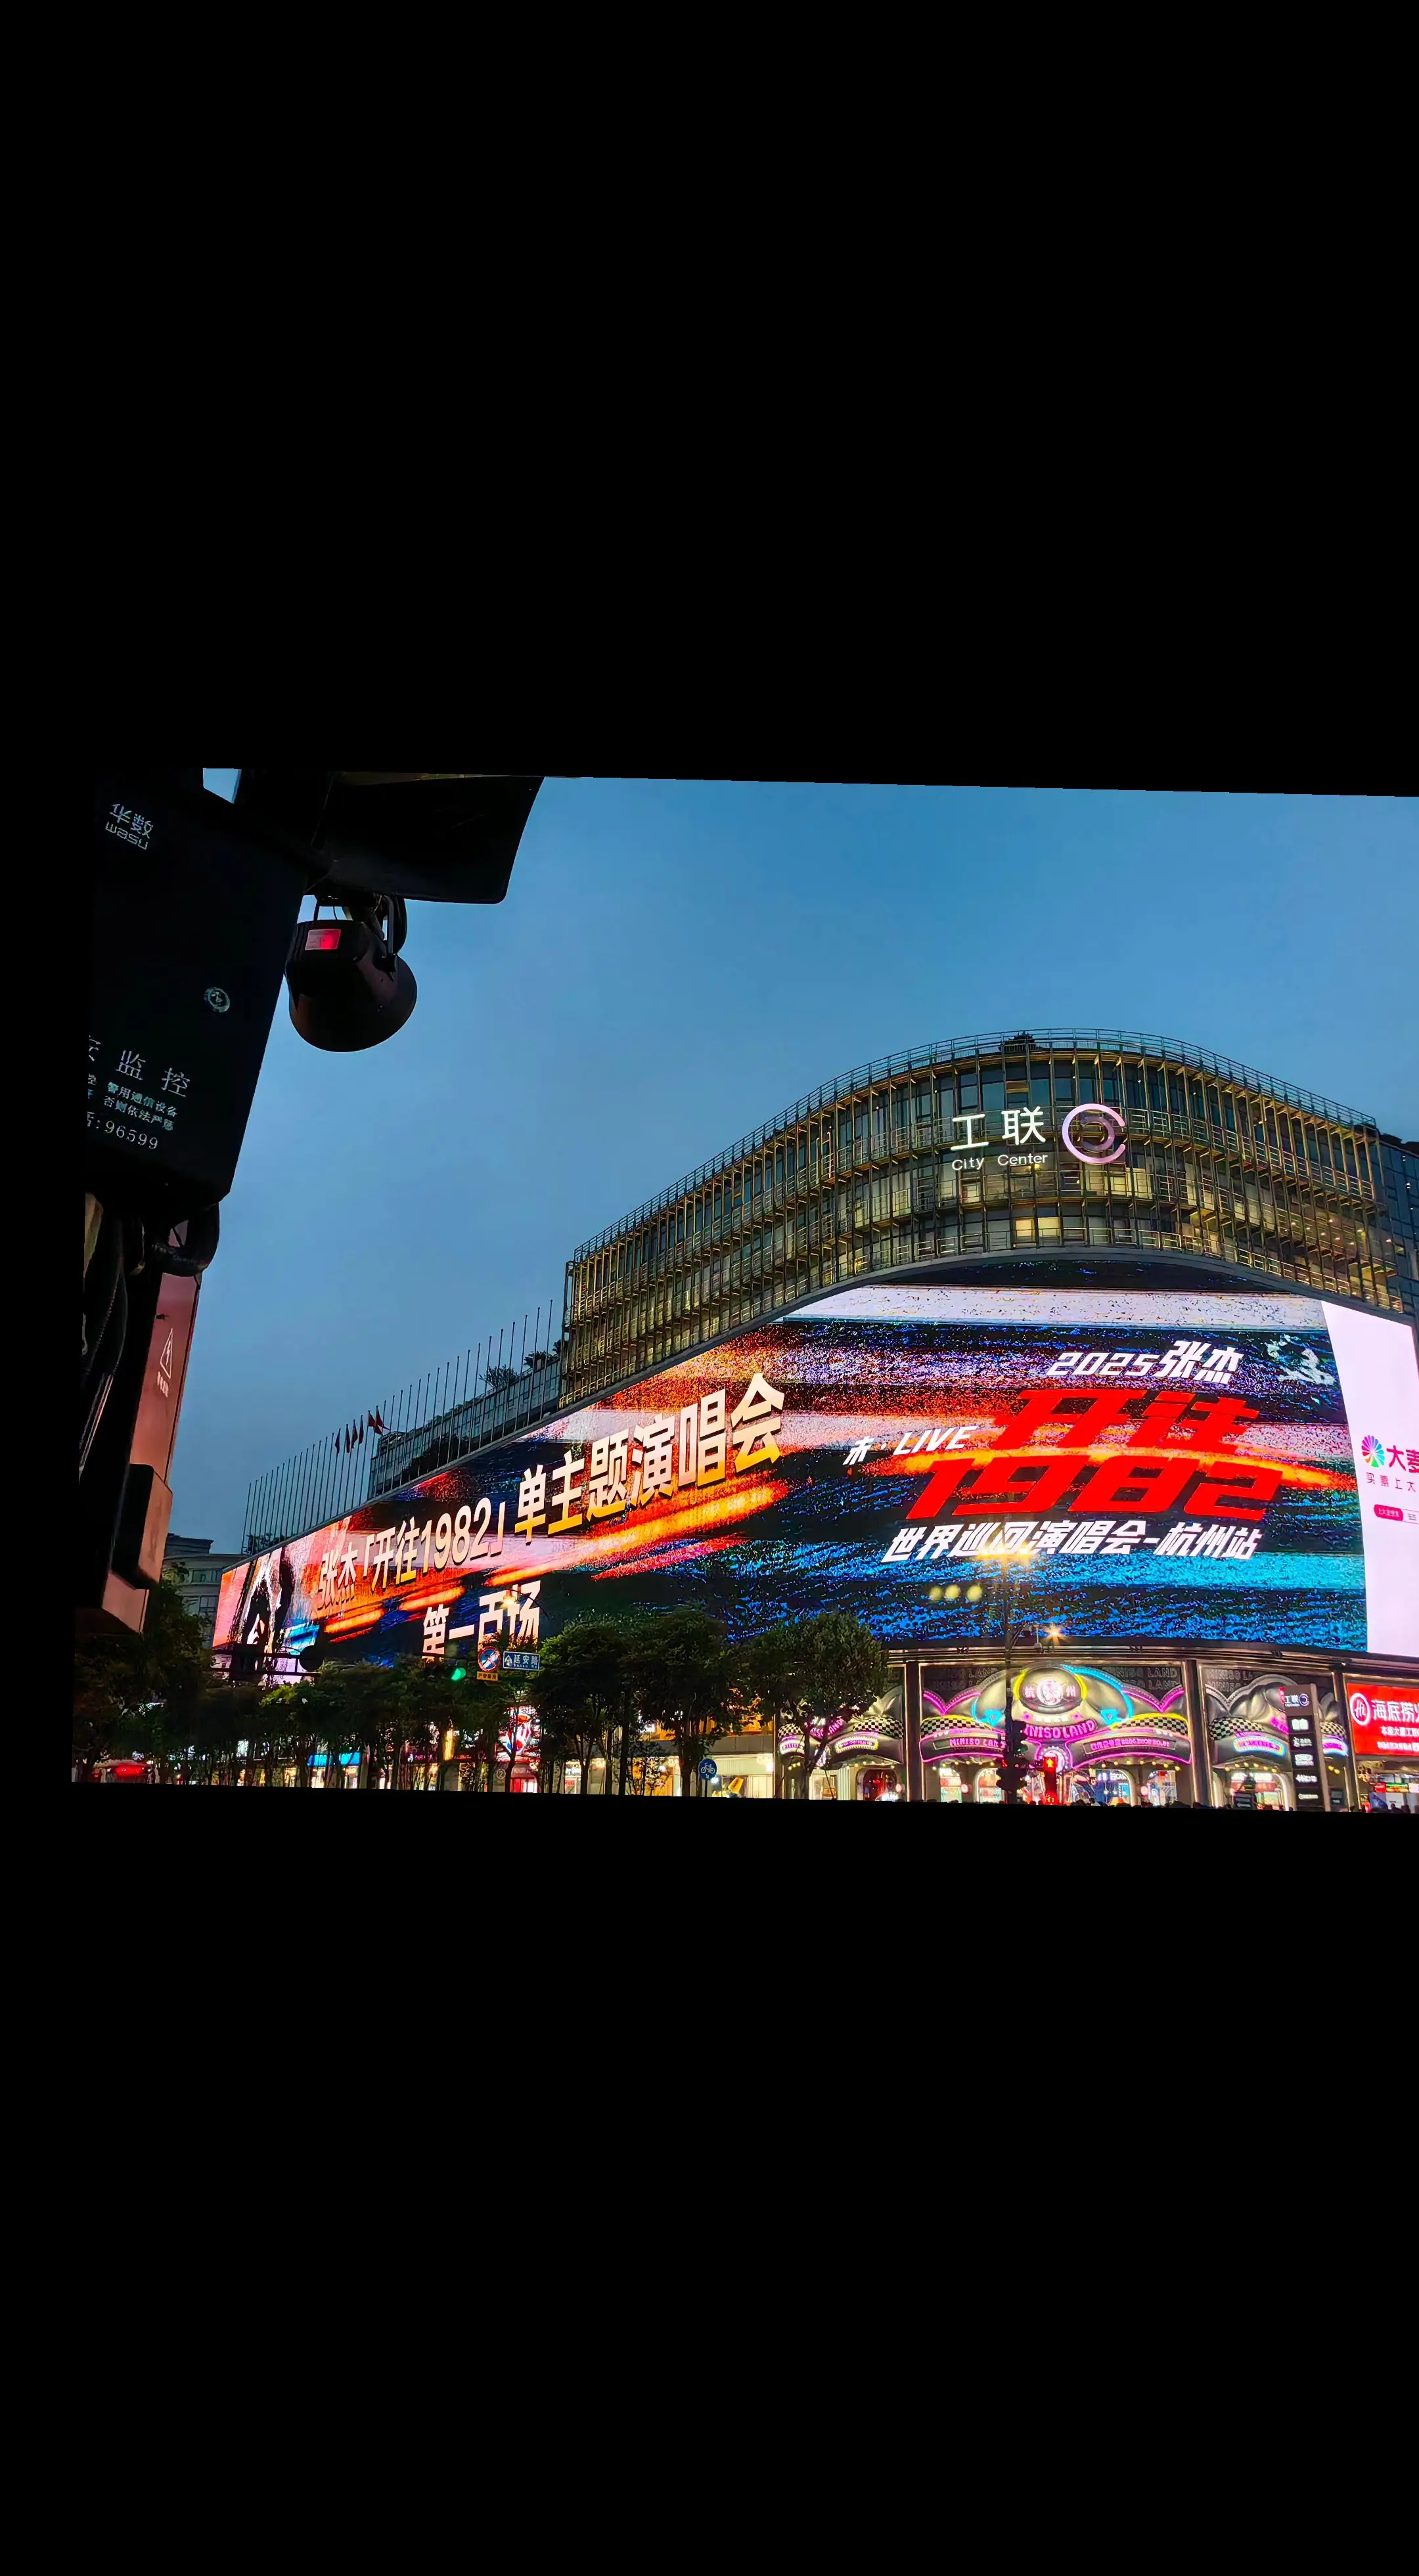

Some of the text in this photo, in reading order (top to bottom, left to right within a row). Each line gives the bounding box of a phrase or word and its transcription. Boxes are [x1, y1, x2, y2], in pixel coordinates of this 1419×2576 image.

[105, 821, 148, 850] wasu
[110, 803, 153, 839] 华数
[951, 1106, 1046, 1151] 工联
[952, 1153, 1048, 1170] City Center
[905, 1455, 1282, 1521] 1982
[1024, 1723, 1062, 1739] INISO
